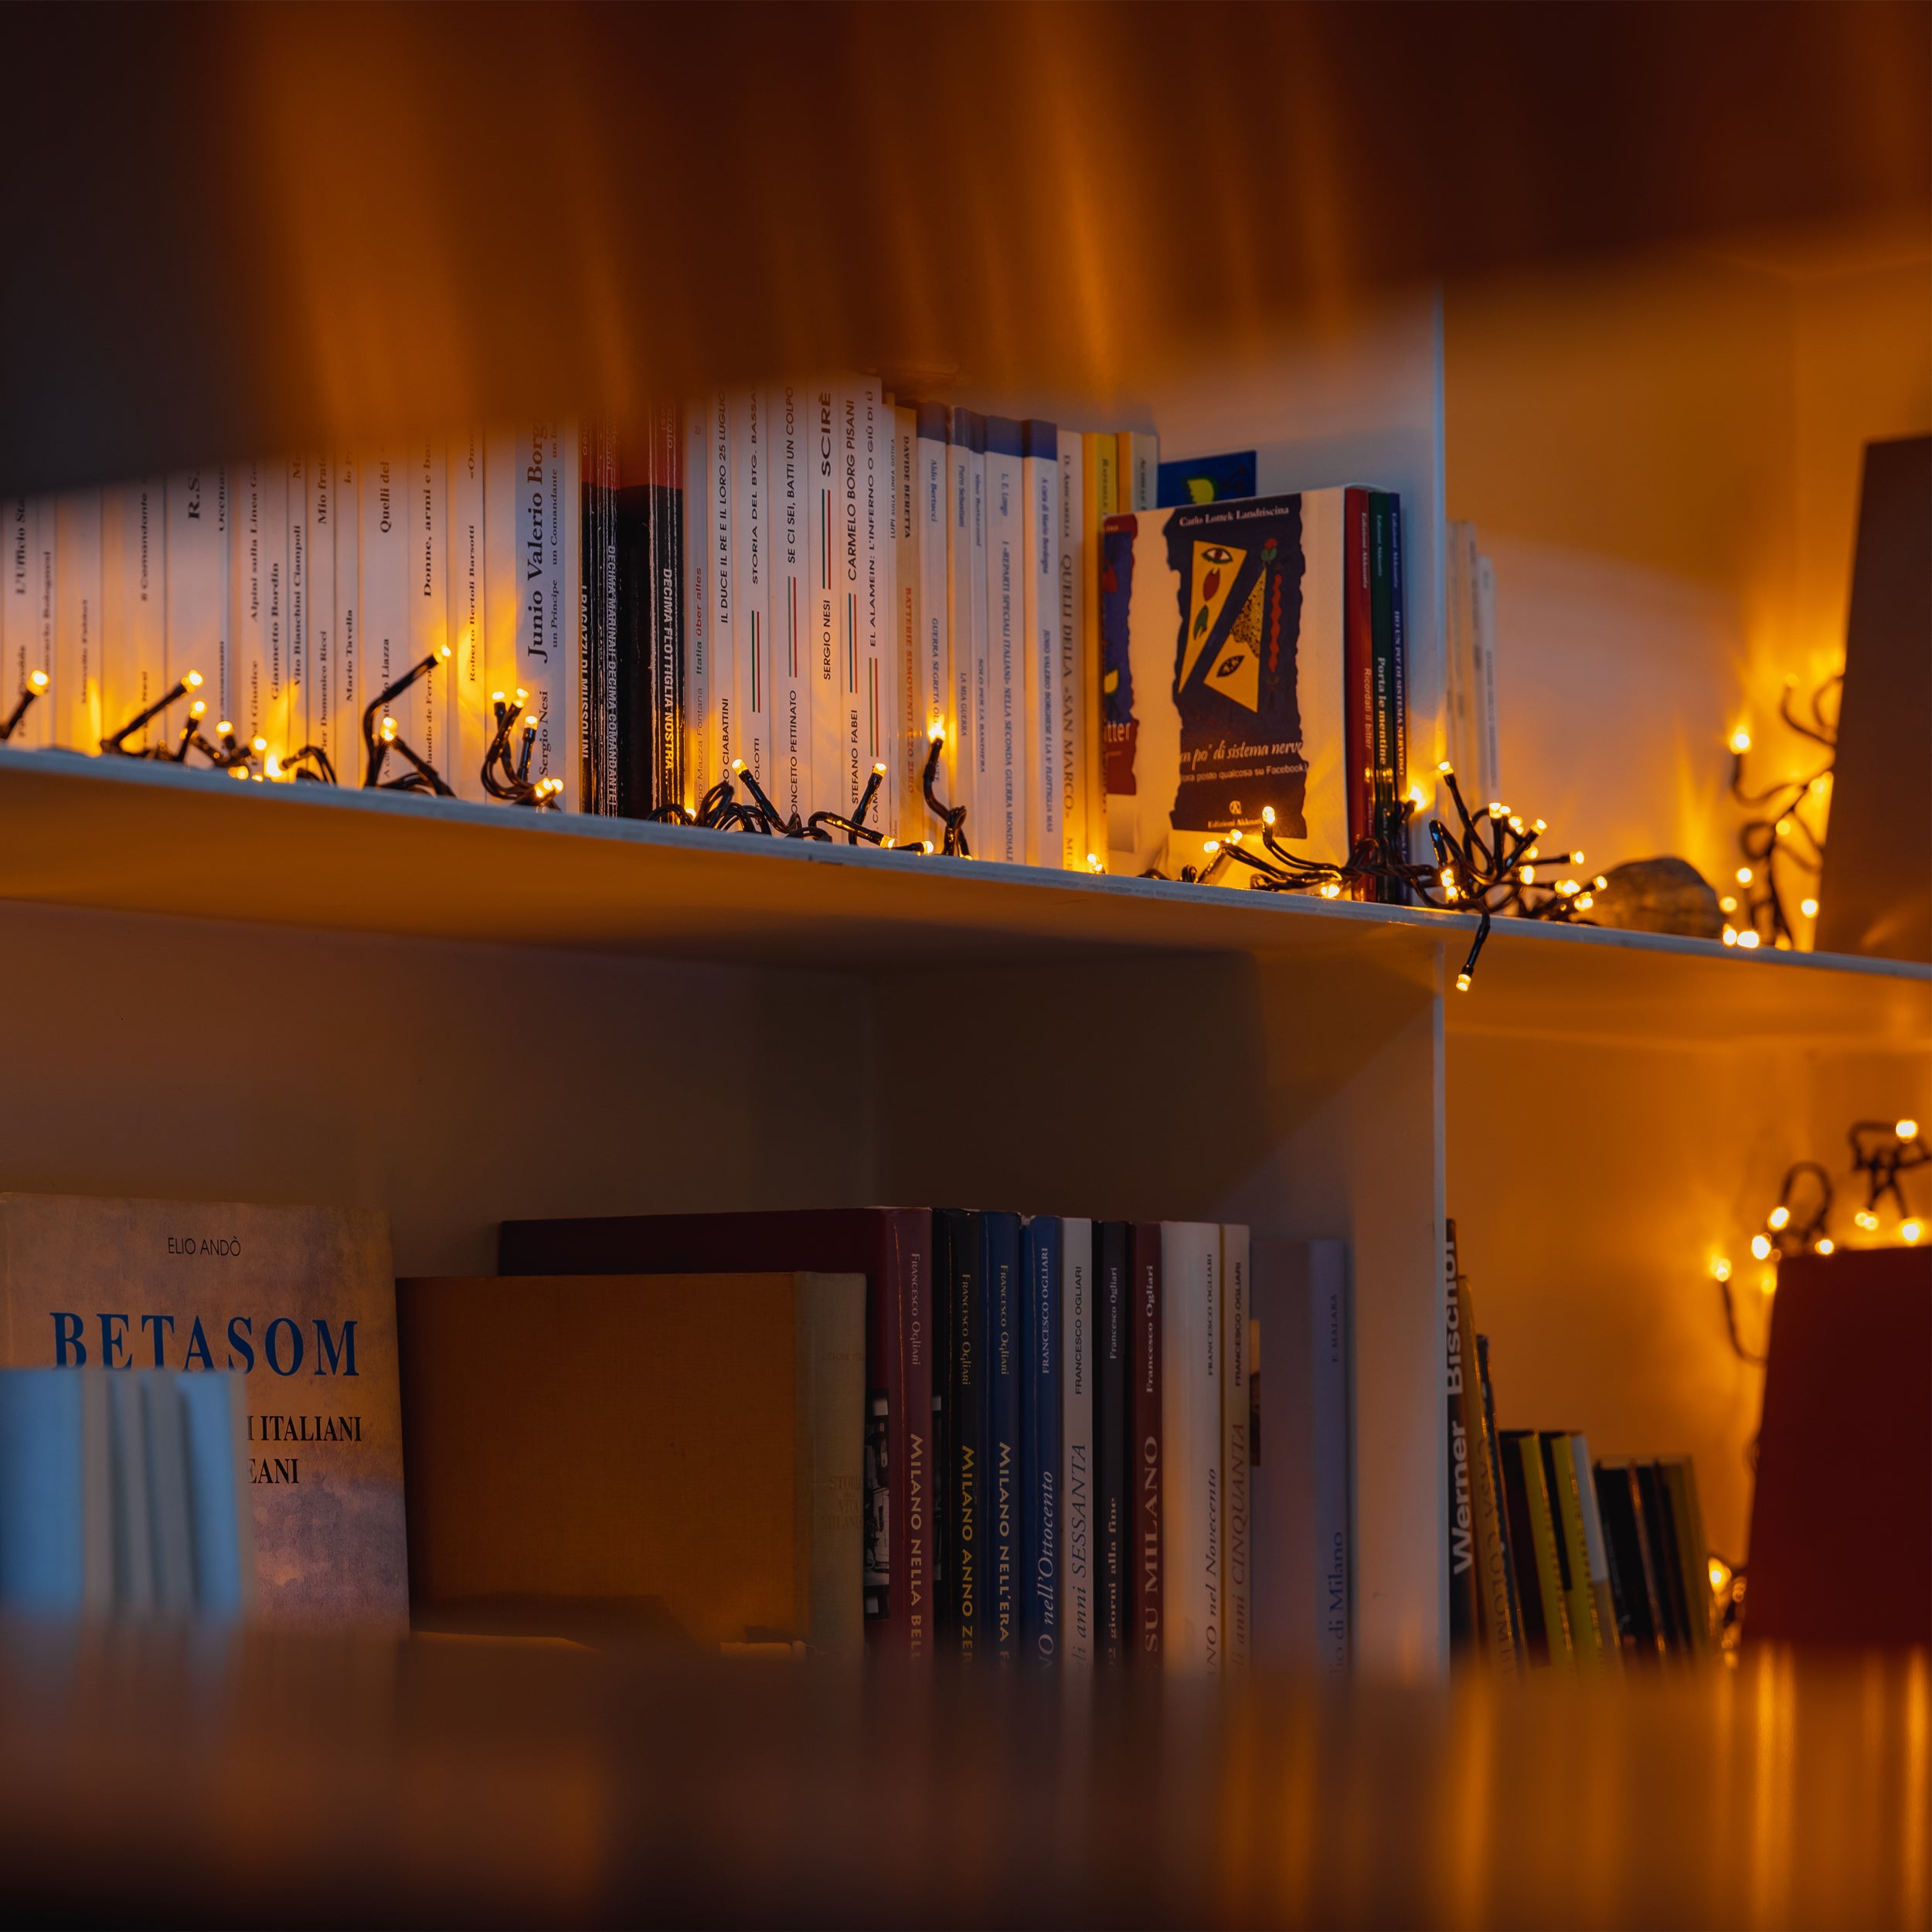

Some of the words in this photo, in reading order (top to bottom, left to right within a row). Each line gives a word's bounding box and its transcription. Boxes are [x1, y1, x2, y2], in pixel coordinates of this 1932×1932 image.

[718, 390, 726, 441] LUGLIO
[818, 392, 832, 478] SCIRÈ
[845, 400, 855, 451] PISANI
[866, 406, 874, 421] DI
[719, 444, 726, 461] 25
[786, 439, 794, 460] UN
[866, 425, 874, 453] GIÙ
[868, 457, 874, 470] O
[903, 435, 911, 481] DAVIDE
[424, 474, 431, 484] e
[719, 464, 727, 505] LORO
[787, 463, 795, 498] BATTI
[846, 454, 856, 500] BORG
[250, 493, 258, 534] Linea
[318, 495, 327, 525] Mio
[379, 488, 392, 534] Quelli
[423, 488, 431, 532] armi
[719, 509, 727, 519] IL
[787, 502, 797, 526] SEI,
[903, 484, 912, 539] BERETTA
[140, 493, 148, 590] Comandante
[250, 539, 258, 574] sulla
[294, 526, 302, 587] Ciampoli
[468, 526, 476, 578] Barsotti
[526, 492, 543, 582] Valerio
[552, 550, 558, 565] un
[719, 535, 727, 552] RE
[719, 555, 727, 566] IL
[787, 529, 796, 546] CI
[787, 549, 796, 565] SE
[847, 504, 857, 581] CARMELO
[423, 536, 433, 597] Donne,
[607, 545, 617, 595] DECIMA
[719, 570, 728, 610] DUCE
[1061, 554, 1073, 618] QUELLI
[250, 578, 261, 623] Alpini
[551, 580, 560, 629] Principe
[663, 568, 672, 623] DECIMA
[720, 613, 728, 624] IL
[822, 599, 831, 628] NESI
[905, 587, 913, 646] BATTERIE
[1002, 594, 1011, 638] SPECIALI
[319, 631, 328, 662] Ricci
[345, 609, 353, 657] Tavella
[526, 590, 548, 664] Junio
[869, 631, 876, 648] EL
[931, 617, 940, 658] GUERRA
[1063, 624, 1073, 679] DELLA
[270, 623, 279, 700] Giannetto
[664, 627, 673, 707] FLOTTIGLIA
[823, 631, 832, 681] SERGIO
[1377, 657, 1388, 692] Porta
[250, 662, 259, 717] Giudice
[607, 661, 617, 709] DECIMA
[932, 660, 940, 704] SEGRETA
[1363, 668, 1373, 711] Ricordati
[1379, 695, 1388, 708] le
[539, 690, 549, 724] Nesi
[789, 690, 798, 753] PETTINATO
[850, 709, 859, 744] FABEI
[539, 729, 551, 776] Sergio
[607, 713, 618, 806] COMANDANTE!
[978, 723, 987, 773] BANDIERA
[1005, 719, 1013, 766] SECONDA
[1213, 739, 1226, 759] di
[1226, 741, 1269, 760] sistema
[1365, 723, 1373, 749] bitter
[1379, 710, 1389, 766] mentine
[789, 757, 798, 815] ONCETTO
[906, 761, 915, 794] ZERO
[1005, 769, 1014, 808] GUERRA
[1046, 766, 1054, 813] FLOTTIGLIA
[1196, 773, 1217, 782] posto
[1219, 769, 1253, 781] qualcosa
[1255, 767, 1265, 777] su
[1005, 811, 1014, 862] MONDIALE
[167, 1236, 196, 1255] ELIO
[199, 1235, 242, 1257] ANDÒ
[1041, 1246, 1049, 1299] OGLIARI
[1108, 1266, 1118, 1304] Ogliari
[1145, 1264, 1155, 1318] Ogliari
[1206, 1253, 1214, 1304] OGLIARI
[1234, 1262, 1243, 1311] OGLIARI
[48, 1311, 360, 1377] BETASOM
[1041, 1301, 1049, 1374] FRANCESCO
[1108, 1306, 1118, 1359] Francesco
[1206, 1306, 1214, 1376] FRANCESCO
[1328, 1294, 1339, 1349] MALARA
[1074, 1318, 1083, 1395] FRANCESCO
[1145, 1322, 1155, 1393] Francesco
[1234, 1313, 1243, 1388] FRANCESCO
[260, 1413, 362, 1443] ITALIANI
[910, 1433, 924, 1531] MILANO
[961, 1444, 975, 1541] MILANO
[998, 1440, 1012, 1537] MILANO
[1231, 1423, 1249, 1587] CINQUANTA
[1451, 1420, 1473, 1575] Werner
[1071, 1443, 1087, 1580] SESSANTA
[1107, 1497, 1117, 1536] fine
[1144, 1436, 1158, 1595] MILANO
[1205, 1468, 1218, 1577] Novecento
[1036, 1470, 1055, 1626] nell'Ottocento
[1107, 1540, 1117, 1577] alla
[910, 1539, 922, 1607] NELLA
[961, 1548, 973, 1617] ANNO
[998, 1545, 1012, 1643] NELL'ERA
[1328, 1532, 1345, 1614] Milano
[1071, 1585, 1087, 1639] anni
[1107, 1583, 1118, 1640] giorni
[1205, 1582, 1218, 1618] nel
[1232, 1594, 1246, 1647] anni
[1144, 1607, 1158, 1652] SU
[1328, 1621, 1344, 1641] di
